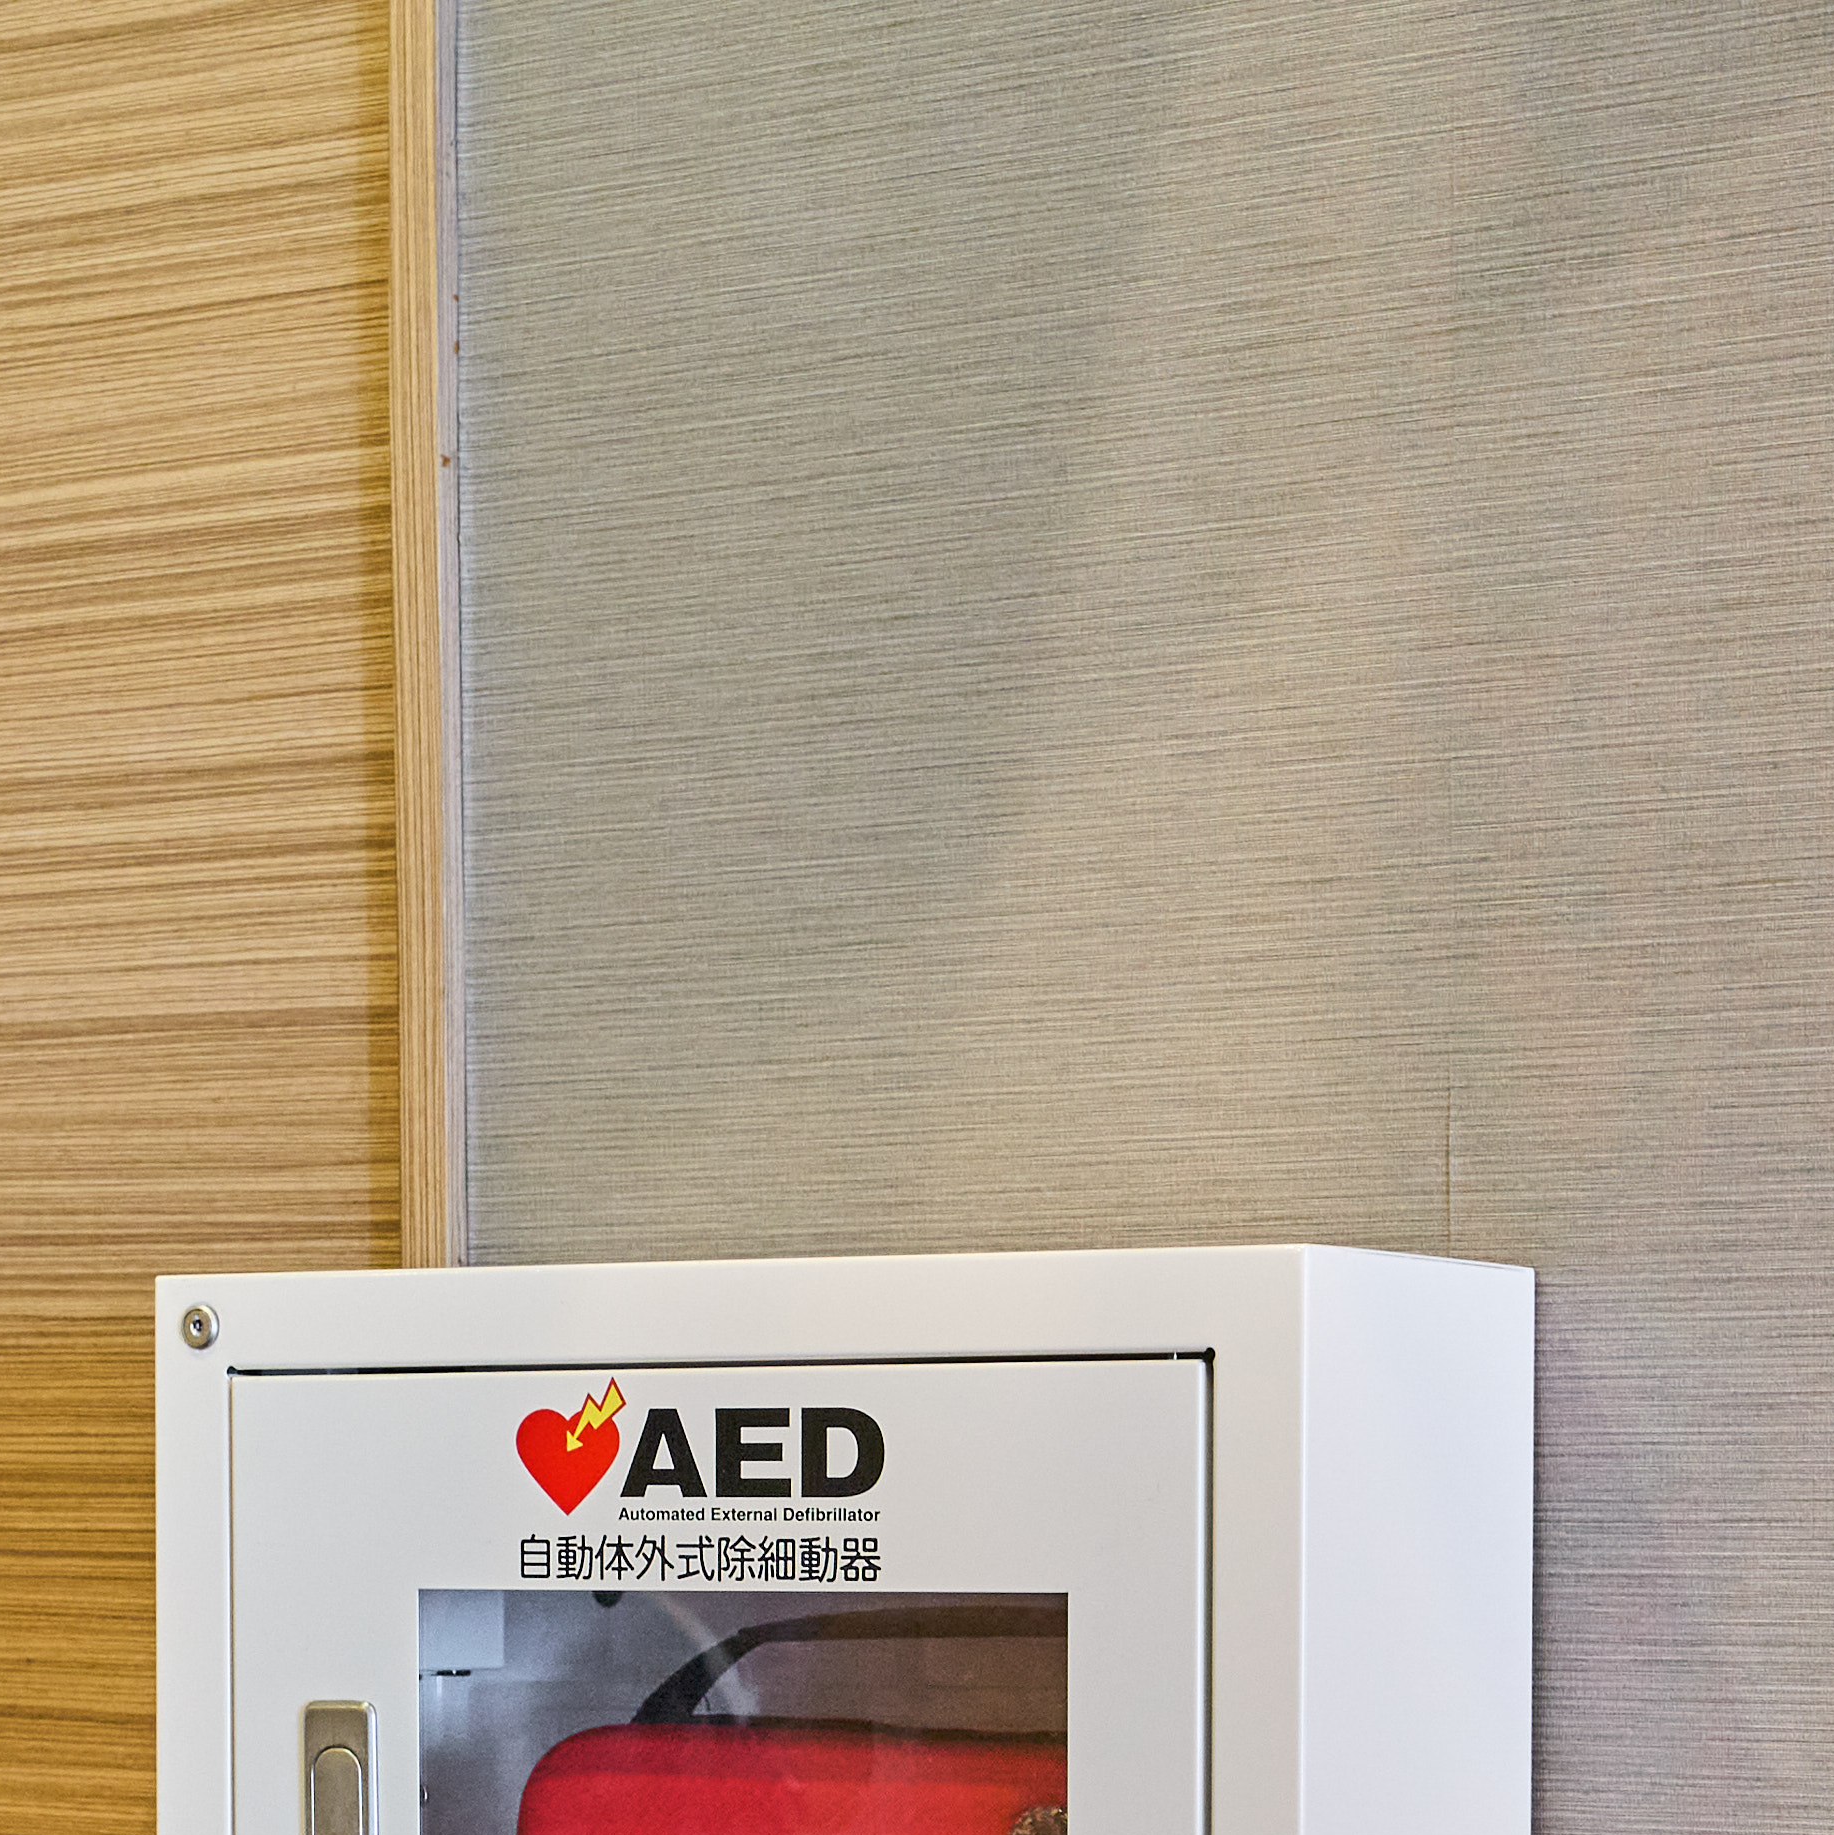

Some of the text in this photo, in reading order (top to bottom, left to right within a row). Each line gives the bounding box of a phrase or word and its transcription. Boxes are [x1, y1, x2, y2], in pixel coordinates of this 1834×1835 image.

[620, 1407, 885, 1498] AED
[619, 1507, 880, 1522] Automated External Defibrillator
[520, 1534, 881, 1582] 自動体外式除細動器
